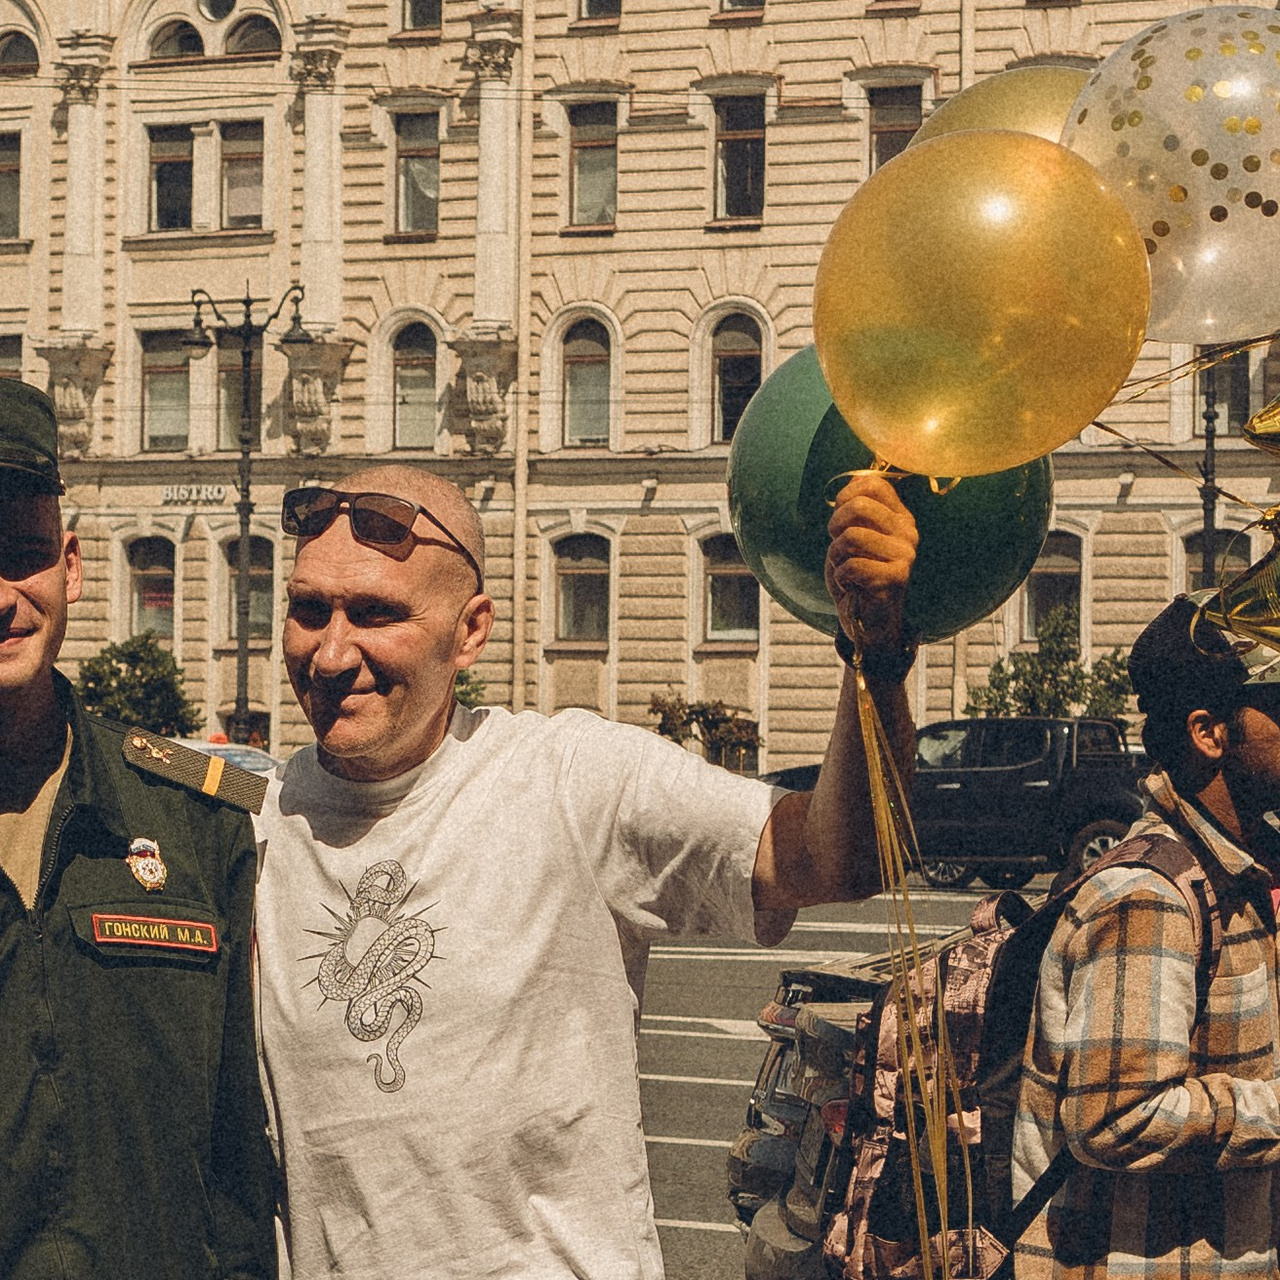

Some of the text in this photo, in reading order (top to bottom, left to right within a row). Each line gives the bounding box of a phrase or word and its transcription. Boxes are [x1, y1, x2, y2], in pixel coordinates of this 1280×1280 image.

[163, 484, 226, 501] BISTRO
[104, 921, 209, 945] ГОНСКИЙ М.А.
